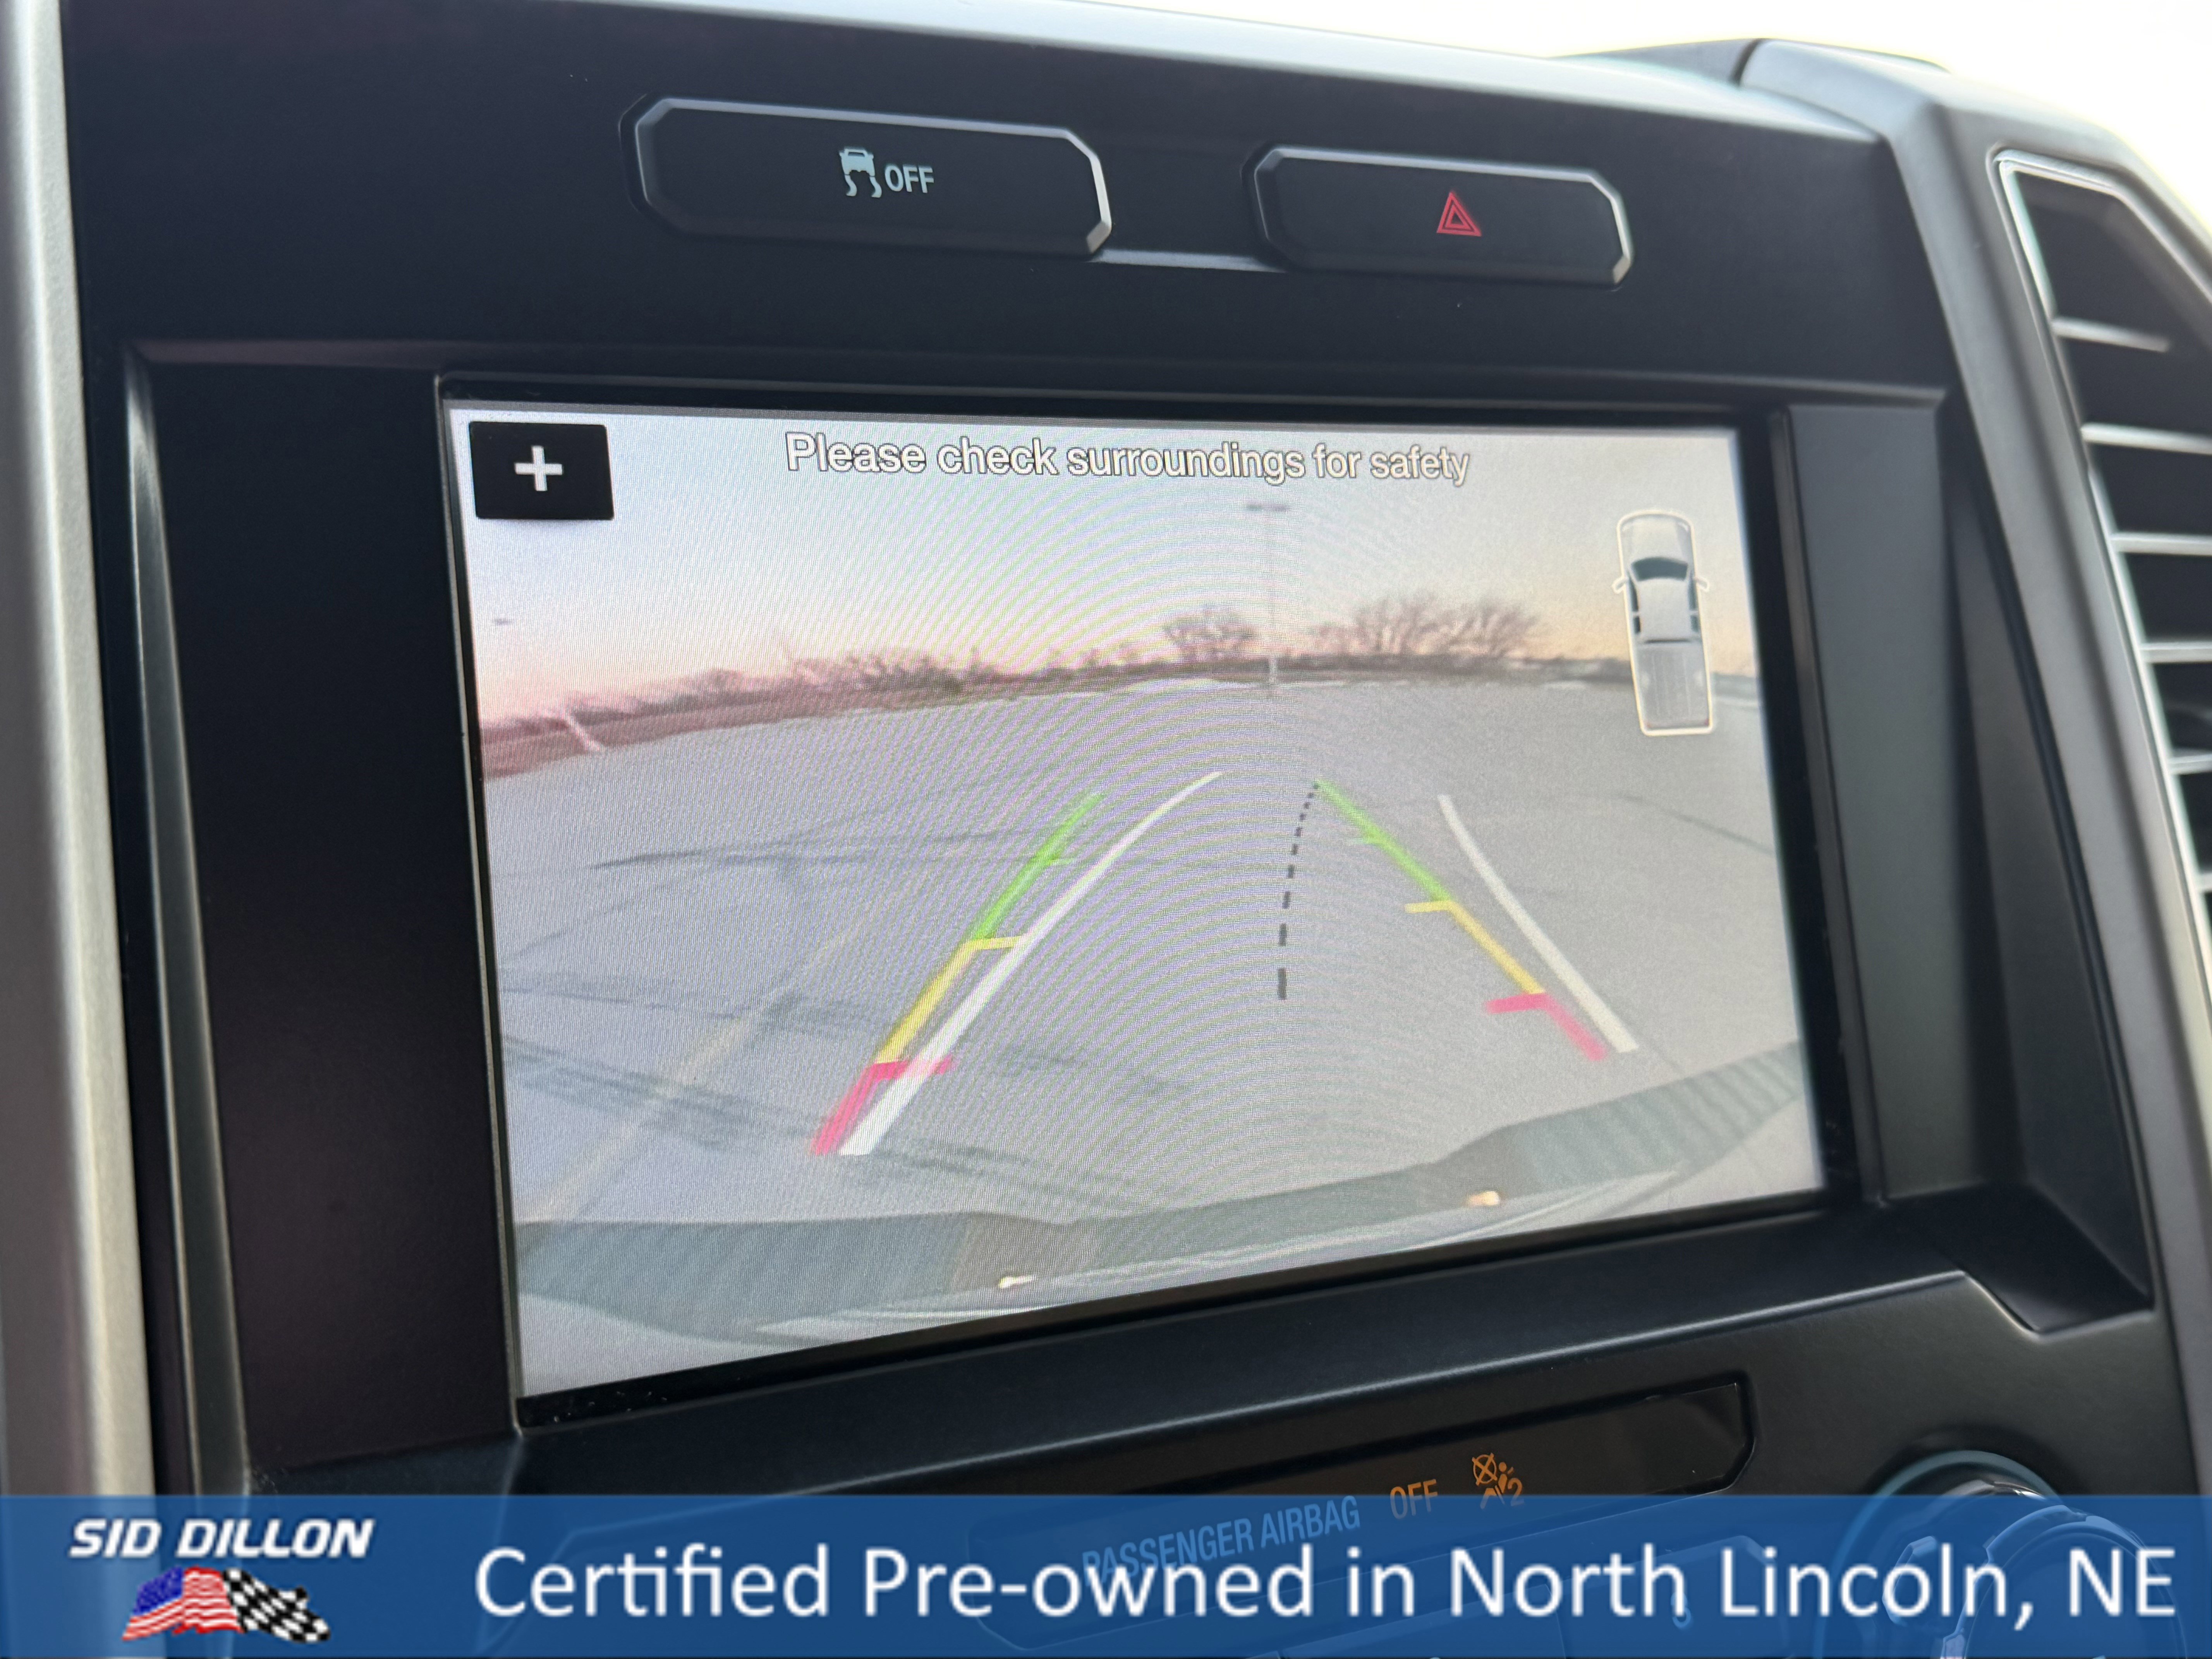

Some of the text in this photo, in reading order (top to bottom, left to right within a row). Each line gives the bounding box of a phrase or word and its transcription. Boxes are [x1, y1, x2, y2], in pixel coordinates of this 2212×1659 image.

[884, 164, 934, 193] OFF
[785, 431, 1470, 487] Please check surroundings for safety
[1508, 1477, 1525, 1507] 2
[1082, 1479, 1438, 1587] PASSENGER AIRBAG OFF
